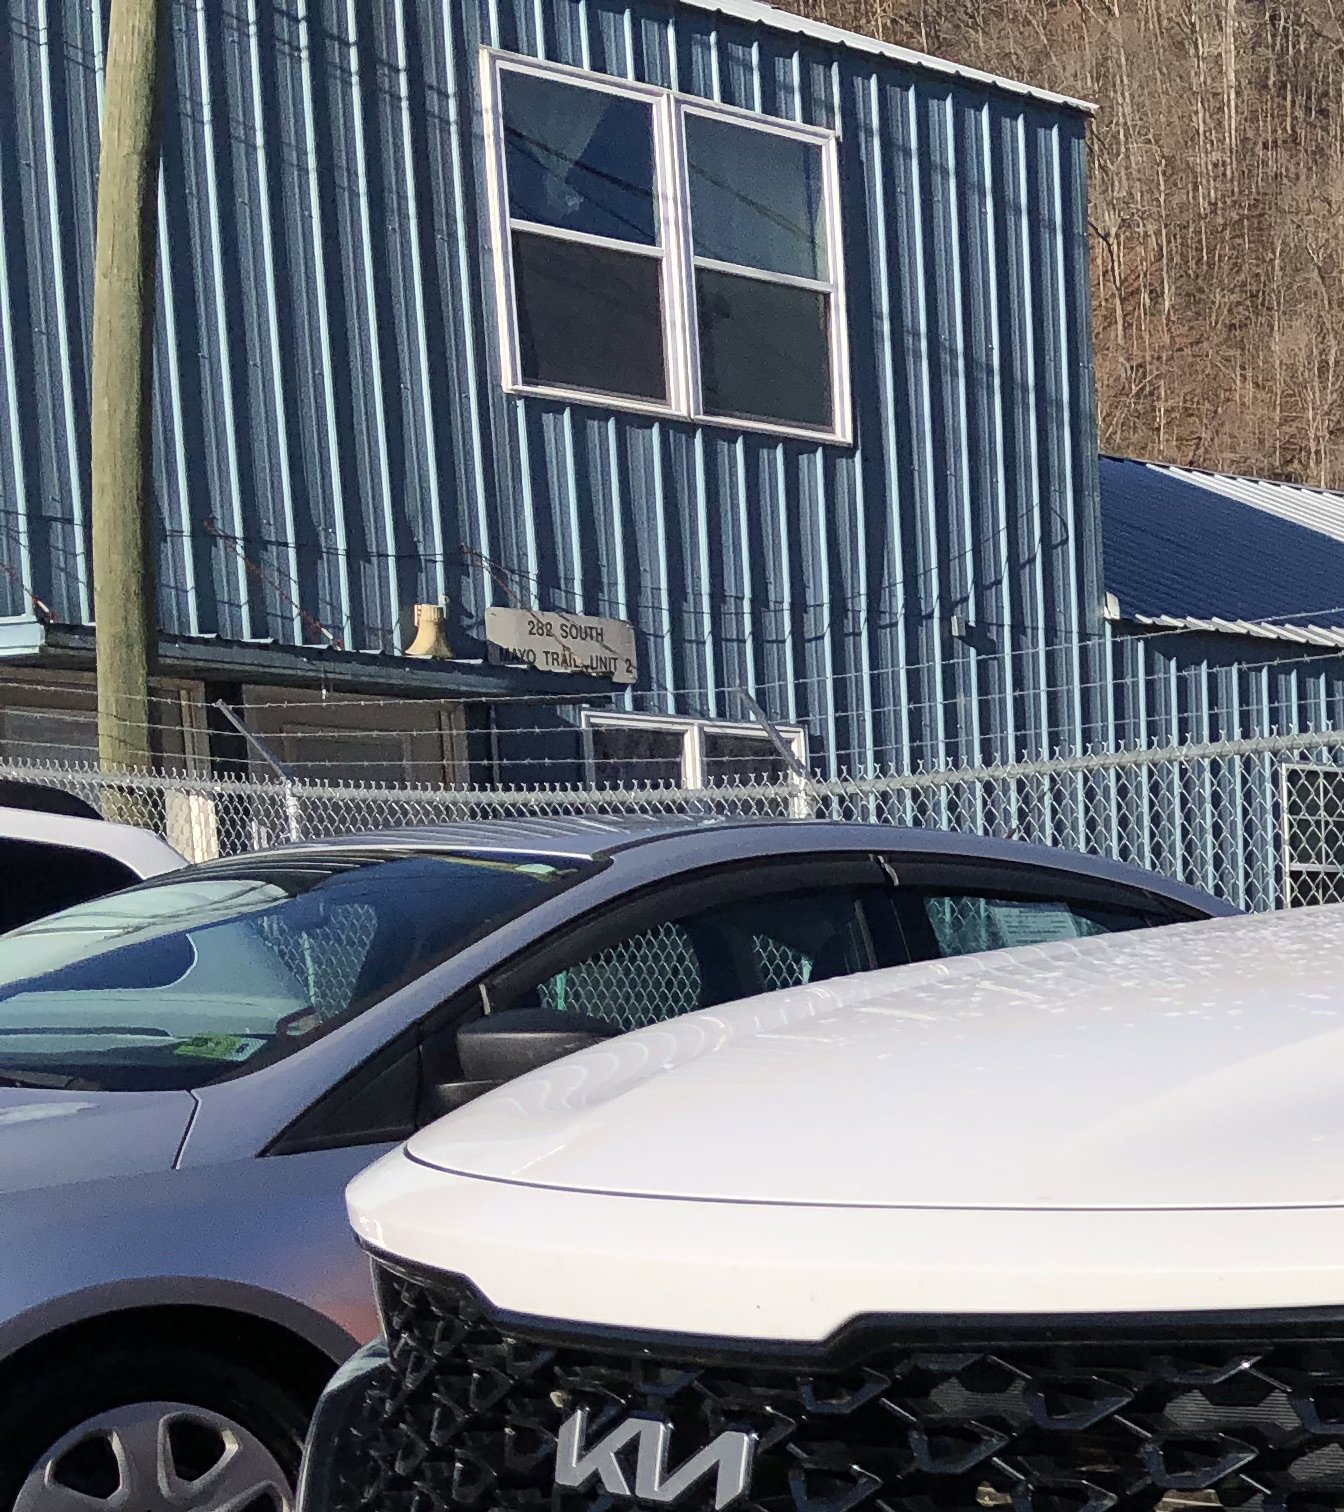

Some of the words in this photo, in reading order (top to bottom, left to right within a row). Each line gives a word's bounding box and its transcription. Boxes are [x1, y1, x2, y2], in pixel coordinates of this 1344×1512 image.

[559, 623, 604, 642] SOUTH
[499, 647, 537, 665] MAYO
[590, 654, 618, 672] UNIT
[625, 658, 633, 673] 2
